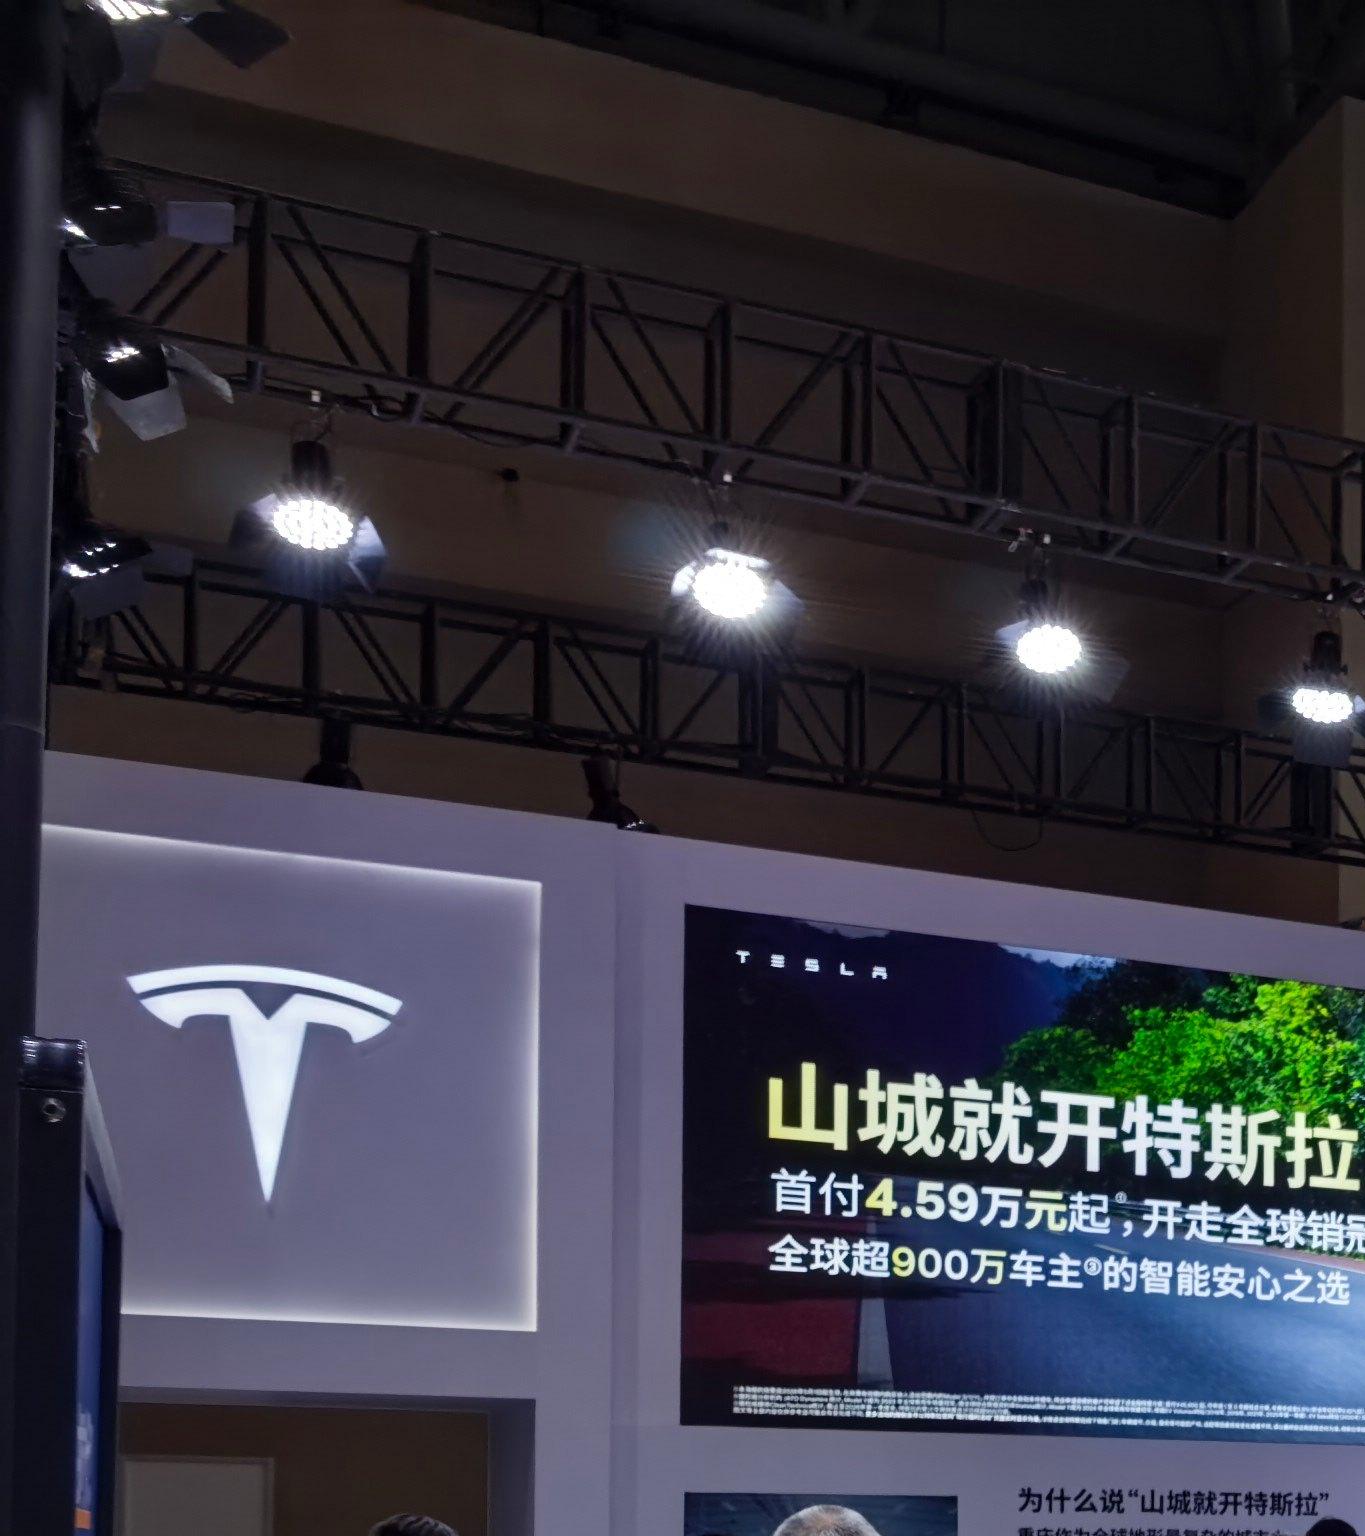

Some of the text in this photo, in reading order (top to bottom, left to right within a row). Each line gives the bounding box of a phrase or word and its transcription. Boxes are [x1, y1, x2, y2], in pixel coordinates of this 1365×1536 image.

[735, 950, 888, 980] TESLA
[768, 1061, 1361, 1192] 山城就开特斯拉
[1018, 1486, 1330, 1518] 为什么说“山城就开特斯拉”
